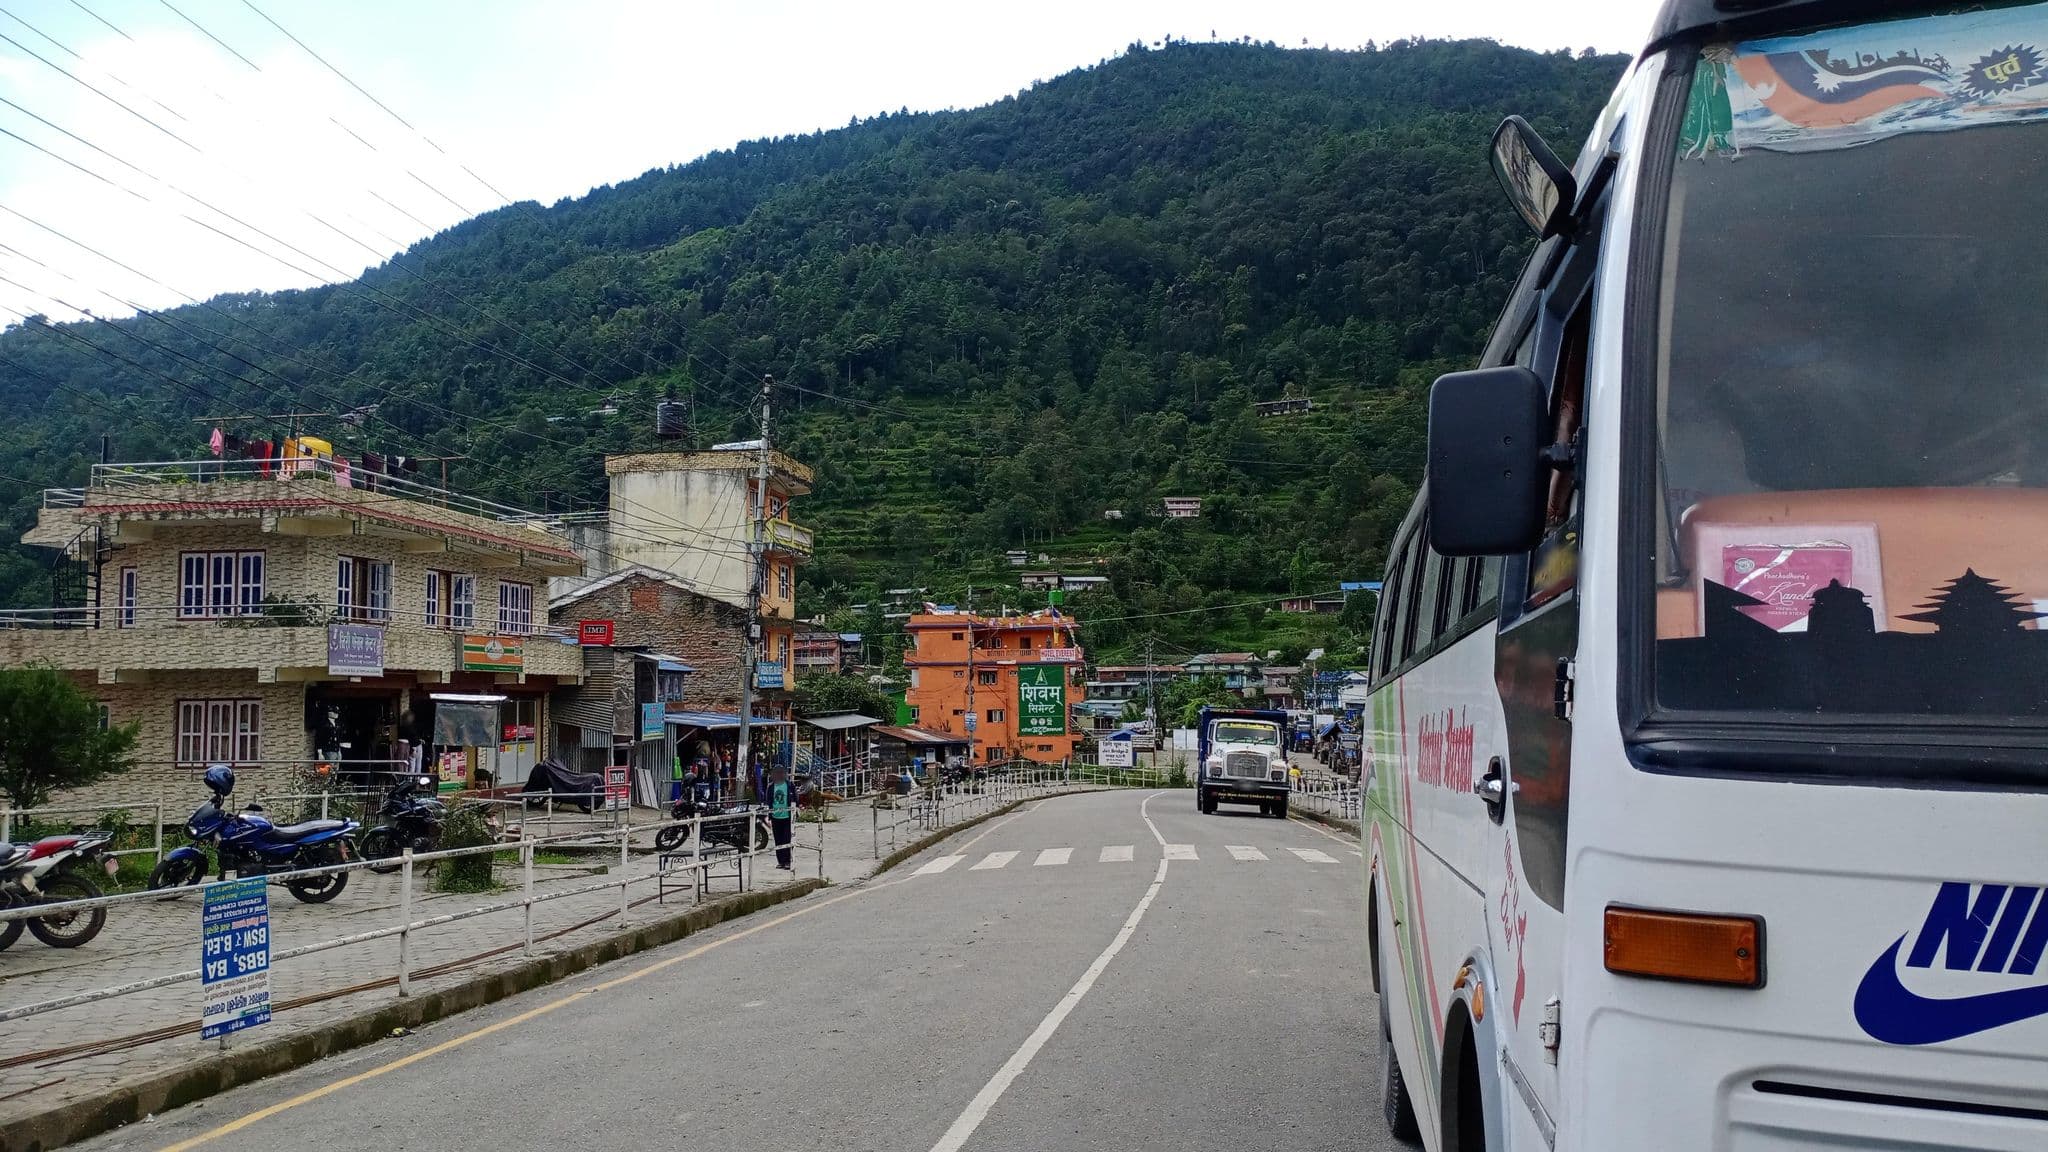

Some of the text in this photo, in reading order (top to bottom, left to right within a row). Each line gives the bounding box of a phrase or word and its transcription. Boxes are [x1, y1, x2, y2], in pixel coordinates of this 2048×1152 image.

[1020, 683, 1063, 706] शिवम्
[1028, 701, 1056, 714] सिमेन्ट
[204, 934, 232, 956] B.Ed.
[243, 927, 266, 948] BSW
[207, 950, 266, 980] BBS, BA
